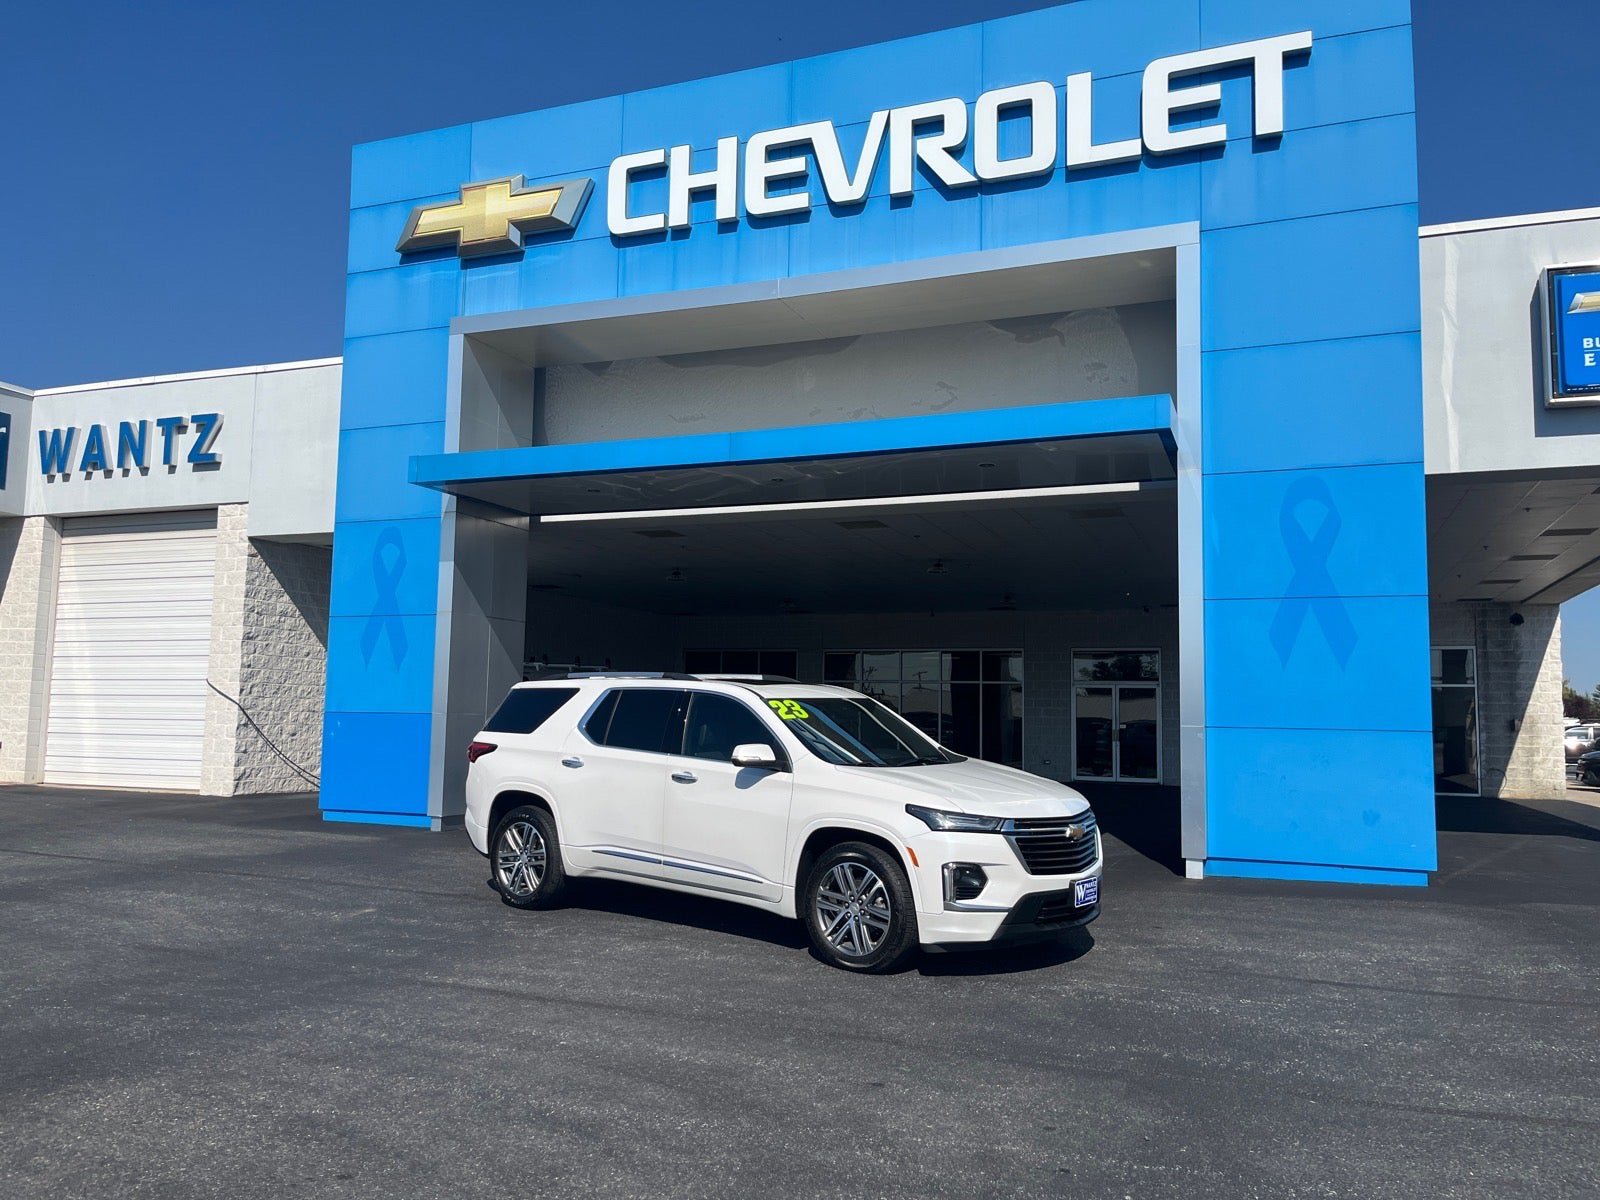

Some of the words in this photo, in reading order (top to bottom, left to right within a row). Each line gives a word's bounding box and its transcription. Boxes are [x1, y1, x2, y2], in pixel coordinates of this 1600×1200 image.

[608, 30, 1313, 237] CHEVROLET
[38, 412, 224, 476] WANTZ
[768, 699, 809, 720] 23
